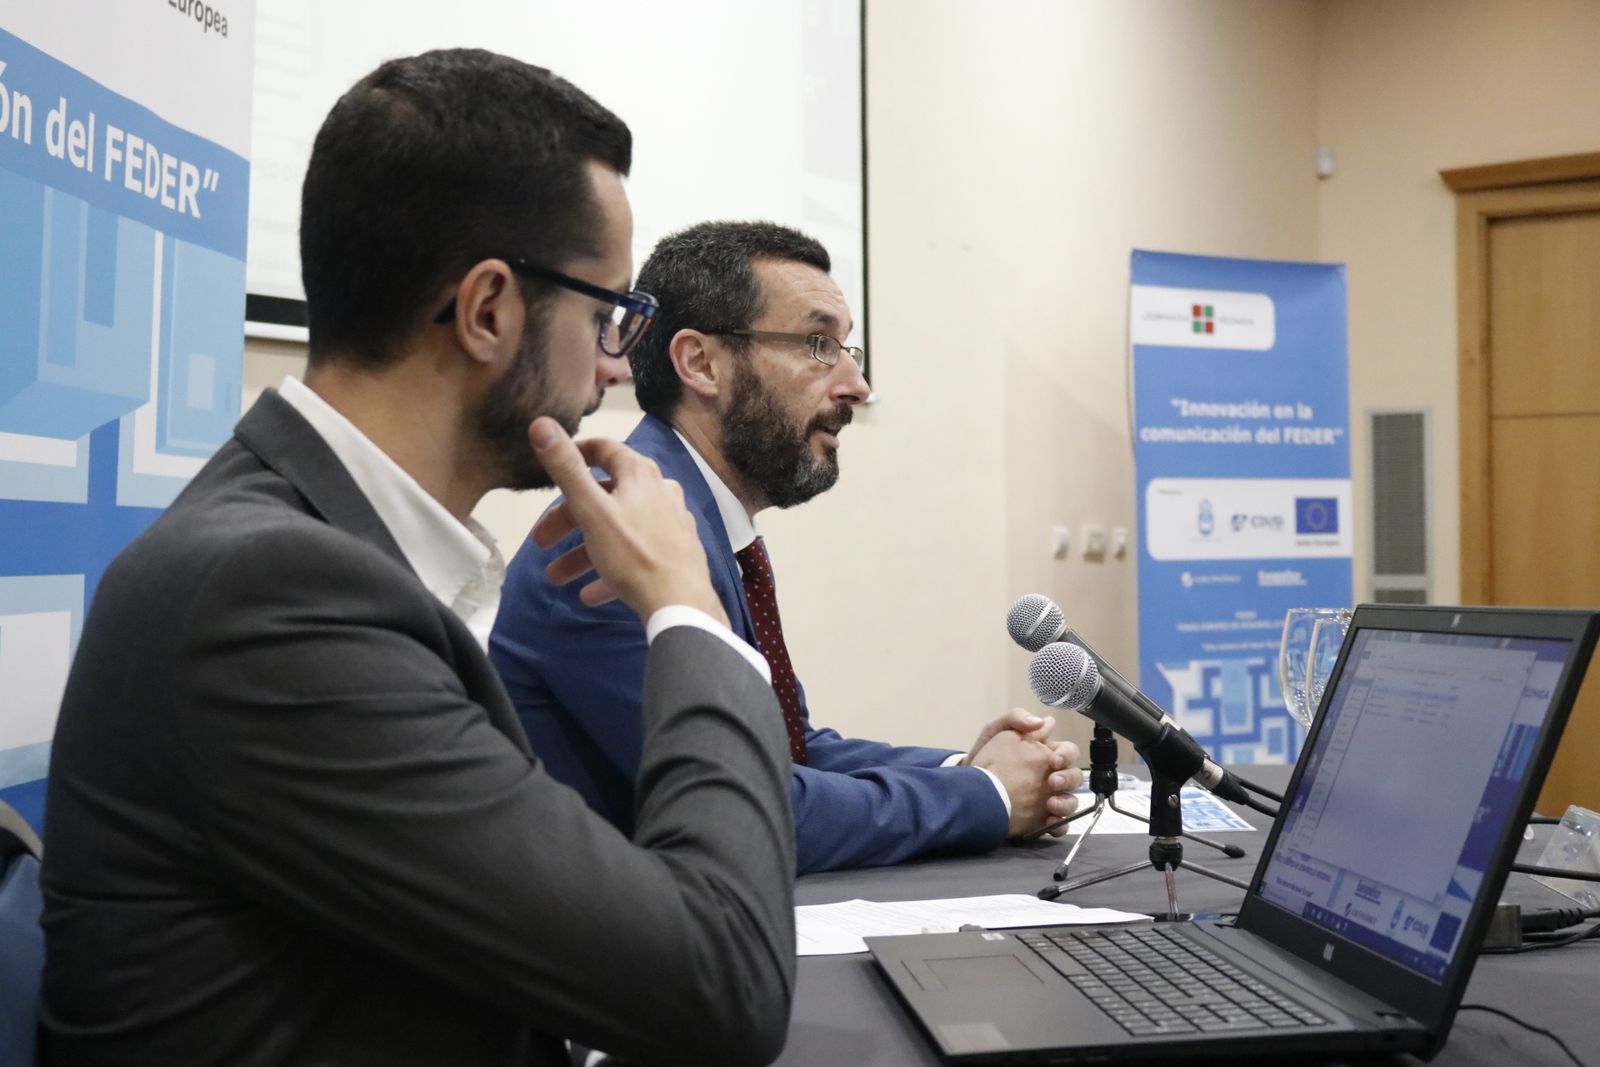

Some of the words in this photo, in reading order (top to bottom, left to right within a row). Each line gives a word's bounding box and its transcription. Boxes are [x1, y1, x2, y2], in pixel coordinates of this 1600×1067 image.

[45, 96, 95, 173] del
[1273, 404, 1294, 419] en
[1297, 402, 1313, 420] la
[1140, 425, 1252, 443] comunicación
[1255, 426, 1281, 443] del
